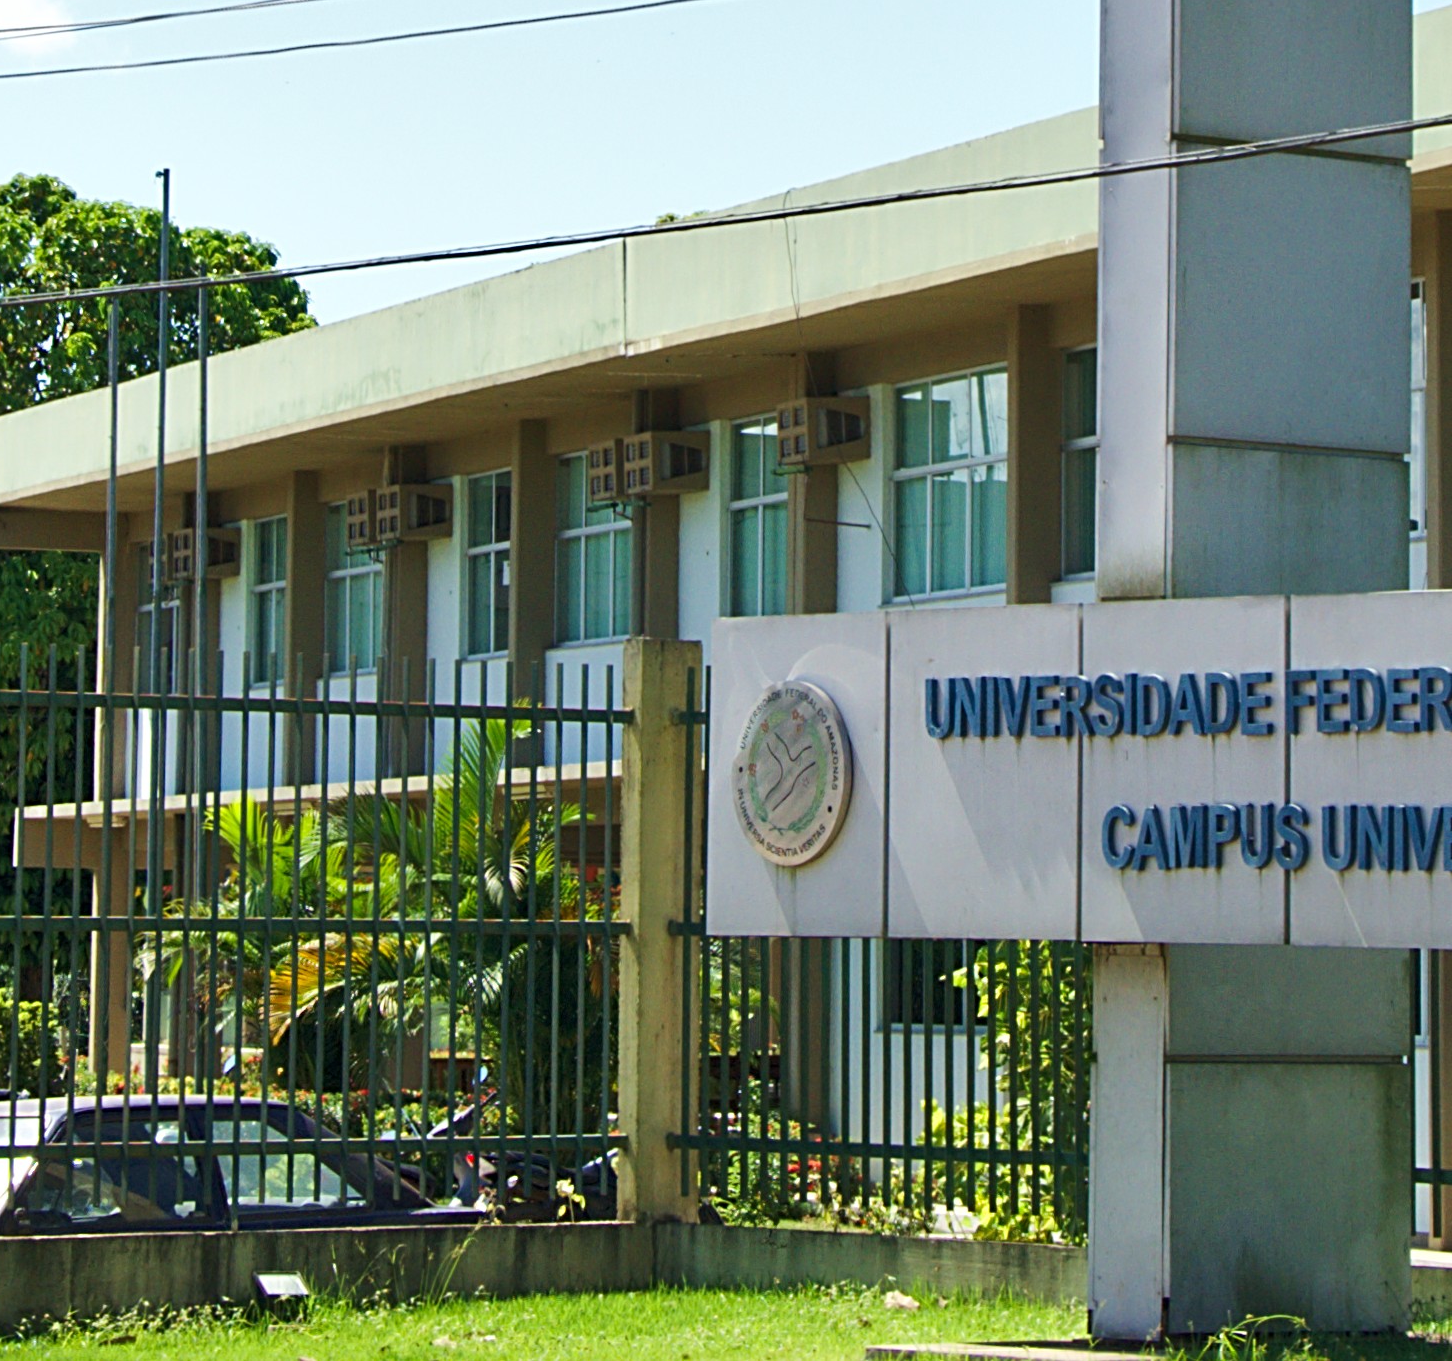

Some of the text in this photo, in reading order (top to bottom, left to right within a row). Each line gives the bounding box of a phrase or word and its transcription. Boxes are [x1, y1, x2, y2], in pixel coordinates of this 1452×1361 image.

[739, 688, 840, 791] UNIVERSIDADE FEDERAL DO AMAZONAS
[924, 670, 1276, 740] UNIVERSIDADE
[765, 841, 799, 857] SCIENTIA
[1100, 801, 1311, 872] CAMPUS
